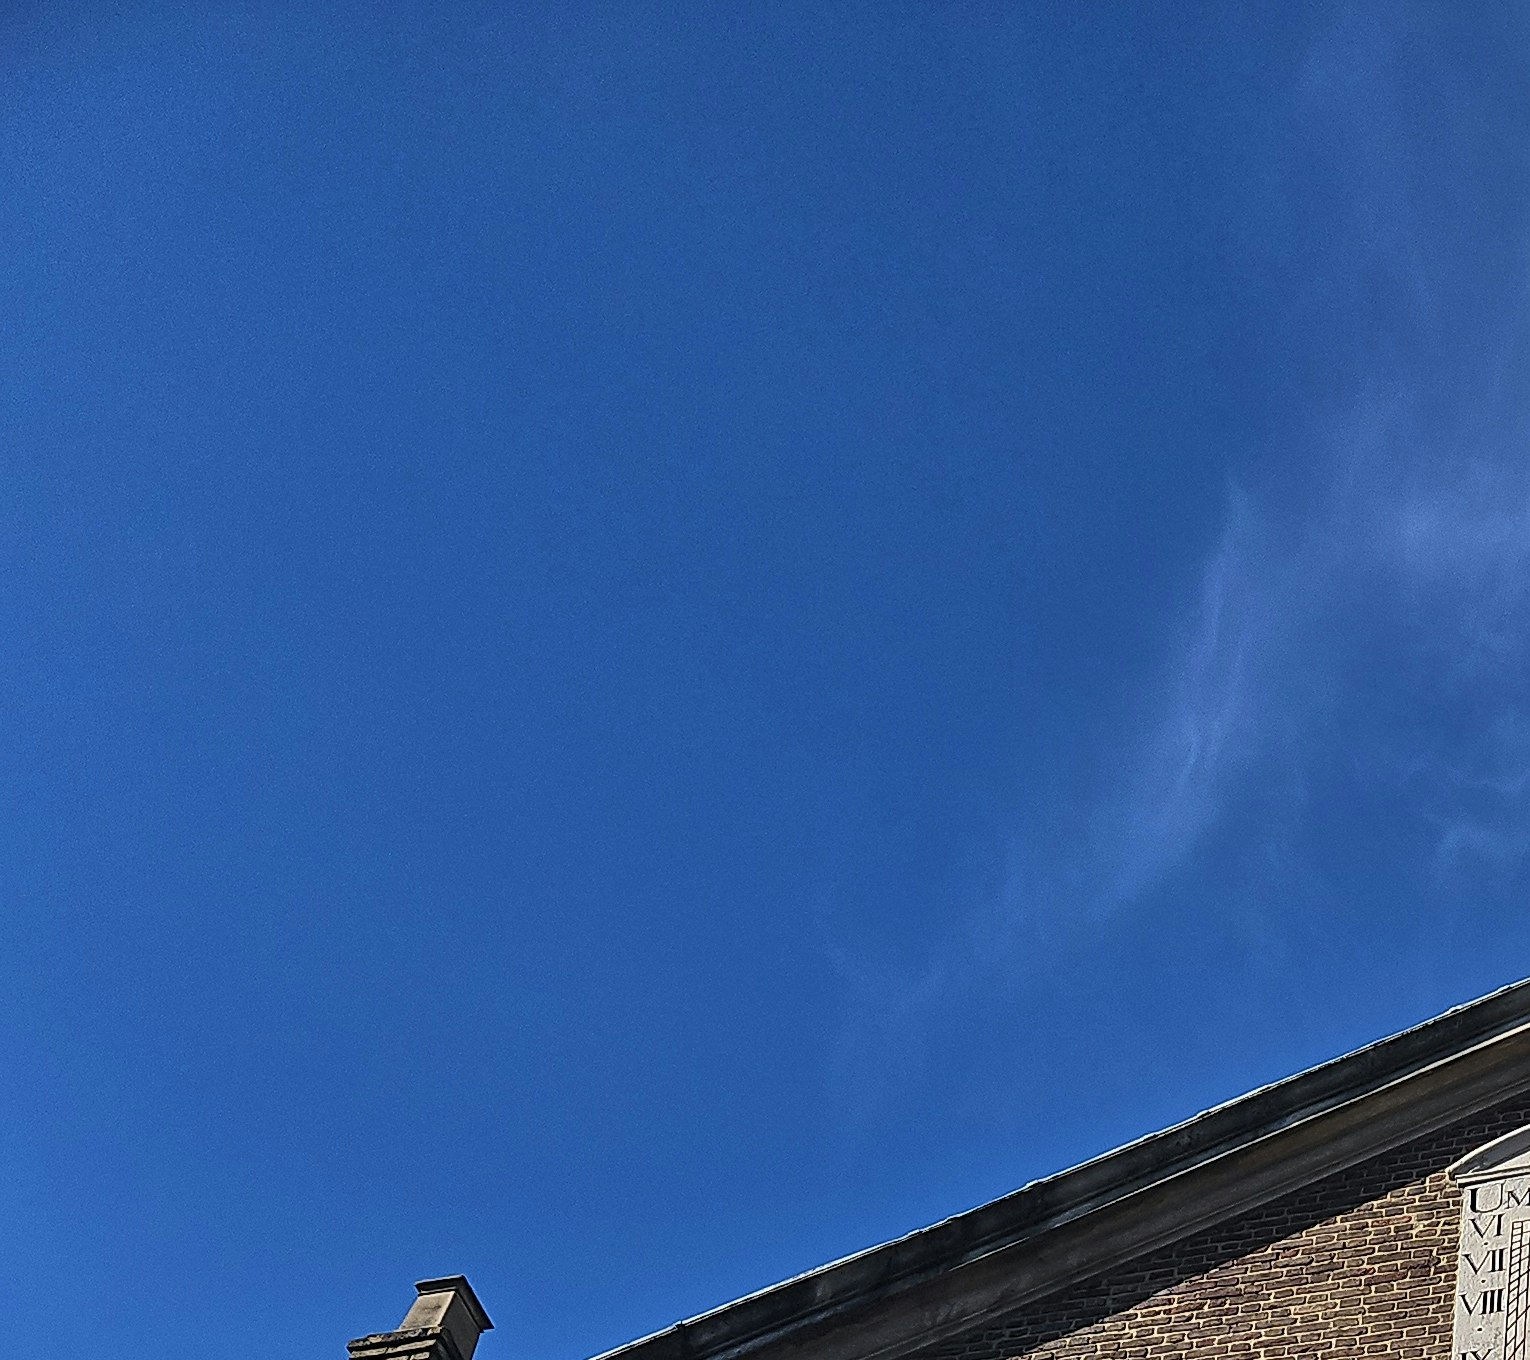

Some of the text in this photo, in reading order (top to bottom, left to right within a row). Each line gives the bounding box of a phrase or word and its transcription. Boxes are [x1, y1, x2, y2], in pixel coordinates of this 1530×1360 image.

[1468, 1213, 1505, 1239] VI
[1462, 1247, 1507, 1275] VII
[1459, 1288, 1506, 1316] VIII
